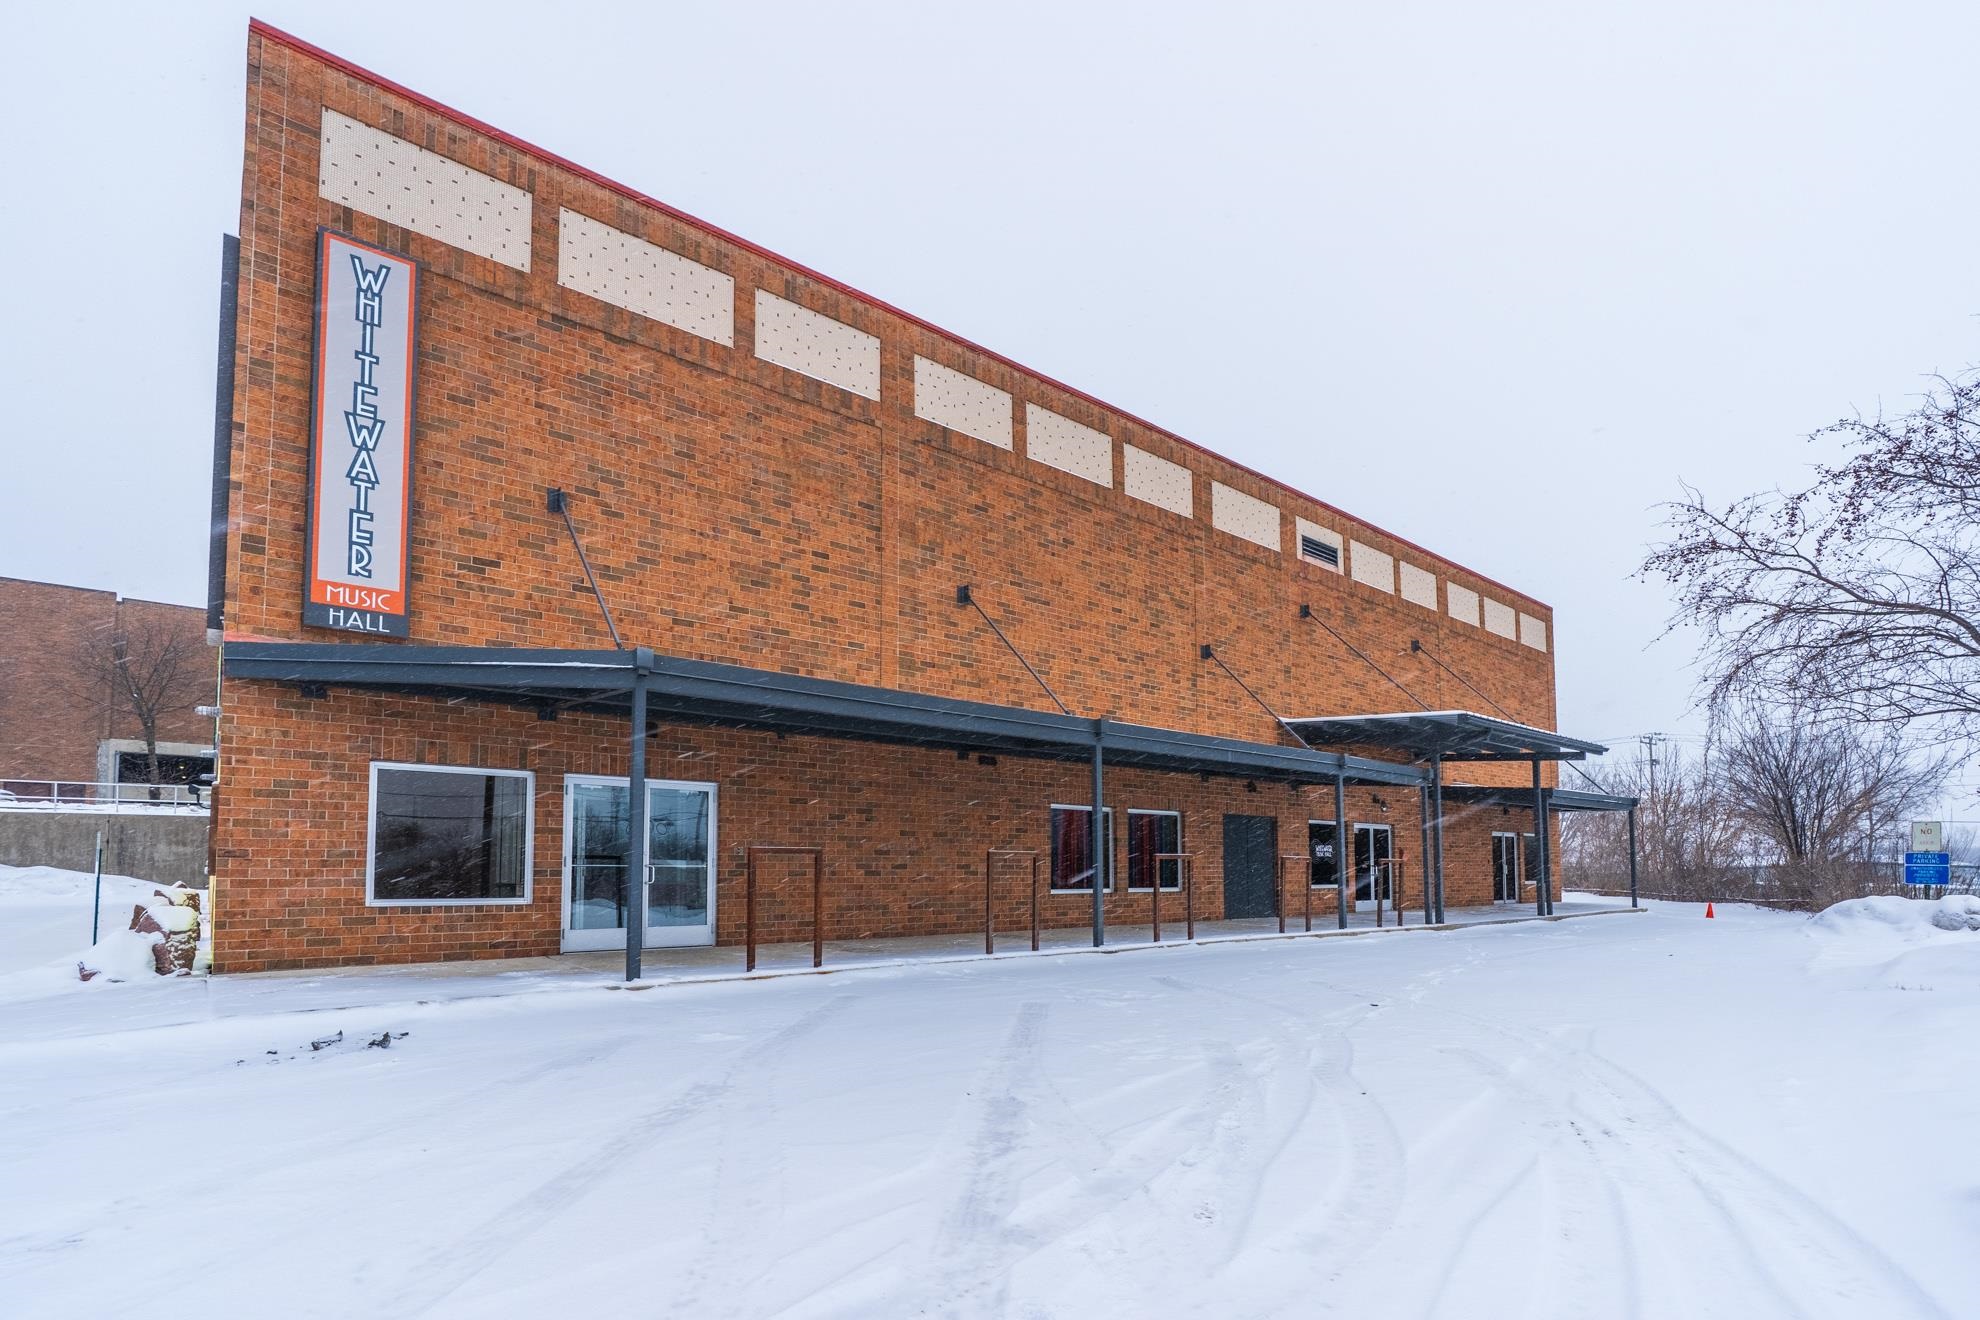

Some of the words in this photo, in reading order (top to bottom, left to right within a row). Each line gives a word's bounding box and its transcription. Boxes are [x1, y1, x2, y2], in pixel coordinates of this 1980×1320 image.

[344, 254, 391, 578] WHITEWATER
[326, 585, 391, 610] MUSIC
[329, 608, 390, 632] HALL
